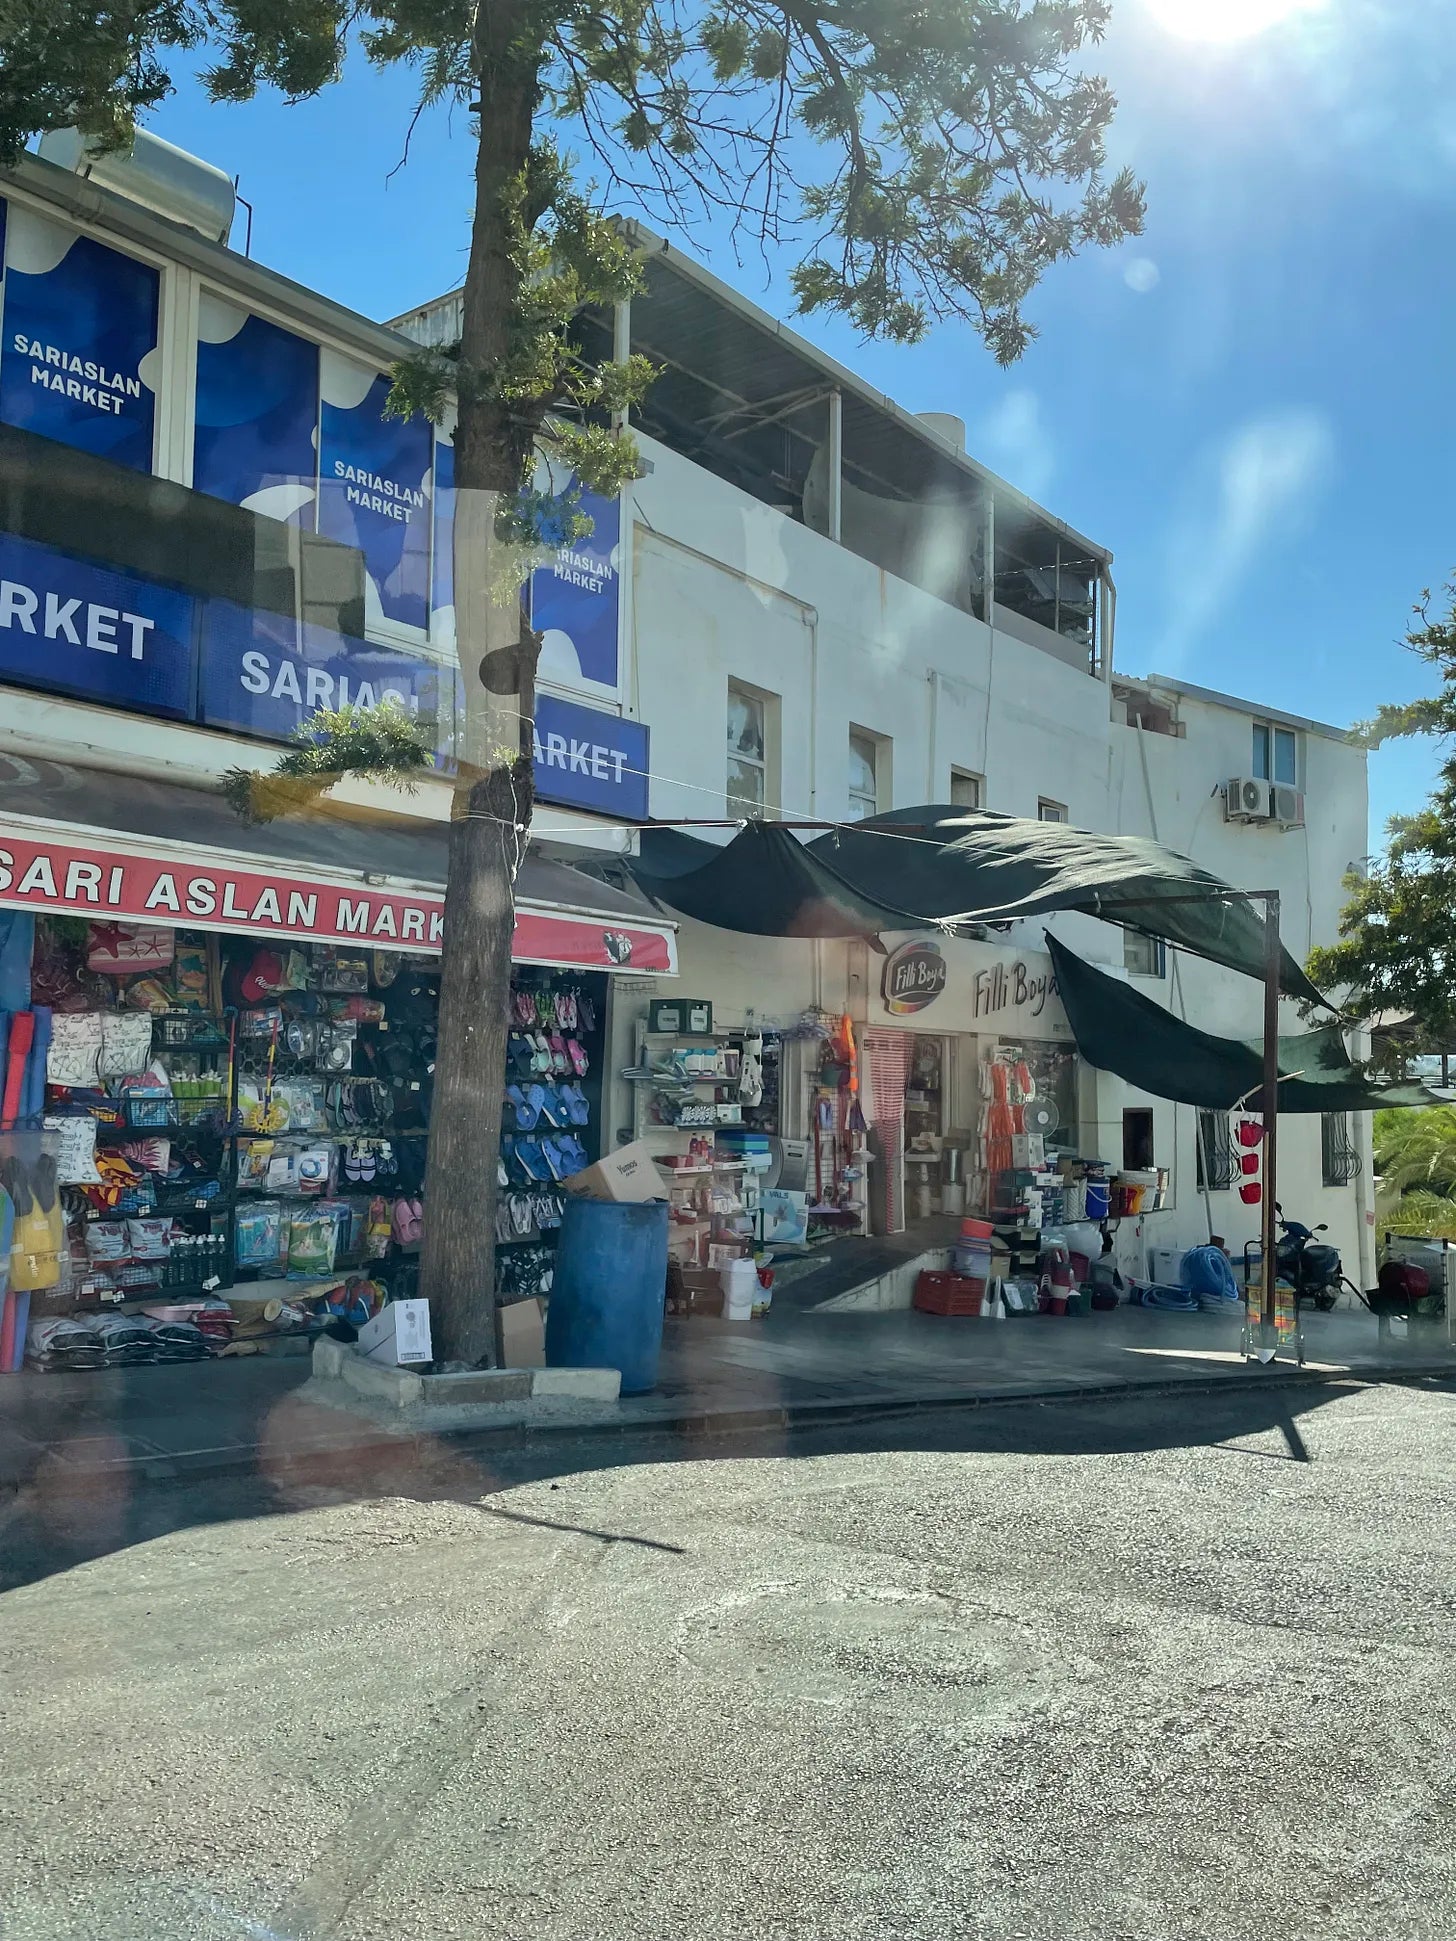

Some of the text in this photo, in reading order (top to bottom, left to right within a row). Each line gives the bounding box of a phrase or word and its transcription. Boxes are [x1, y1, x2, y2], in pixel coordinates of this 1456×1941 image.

[14, 334, 140, 398] SARIASLAN
[31, 365, 124, 415] MARKET
[334, 460, 424, 508] SARIASLAN
[347, 486, 413, 524] MARKET
[554, 564, 604, 594] MARKET
[557, 549, 612, 580] RIASLAN
[0, 579, 155, 660] RKET
[532, 728, 628, 784] ARKET
[144, 872, 318, 928] ASLAN
[335, 897, 445, 943] MARK
[896, 961, 945, 991] Filli Boya
[973, 961, 1061, 1019] Filli Boya
